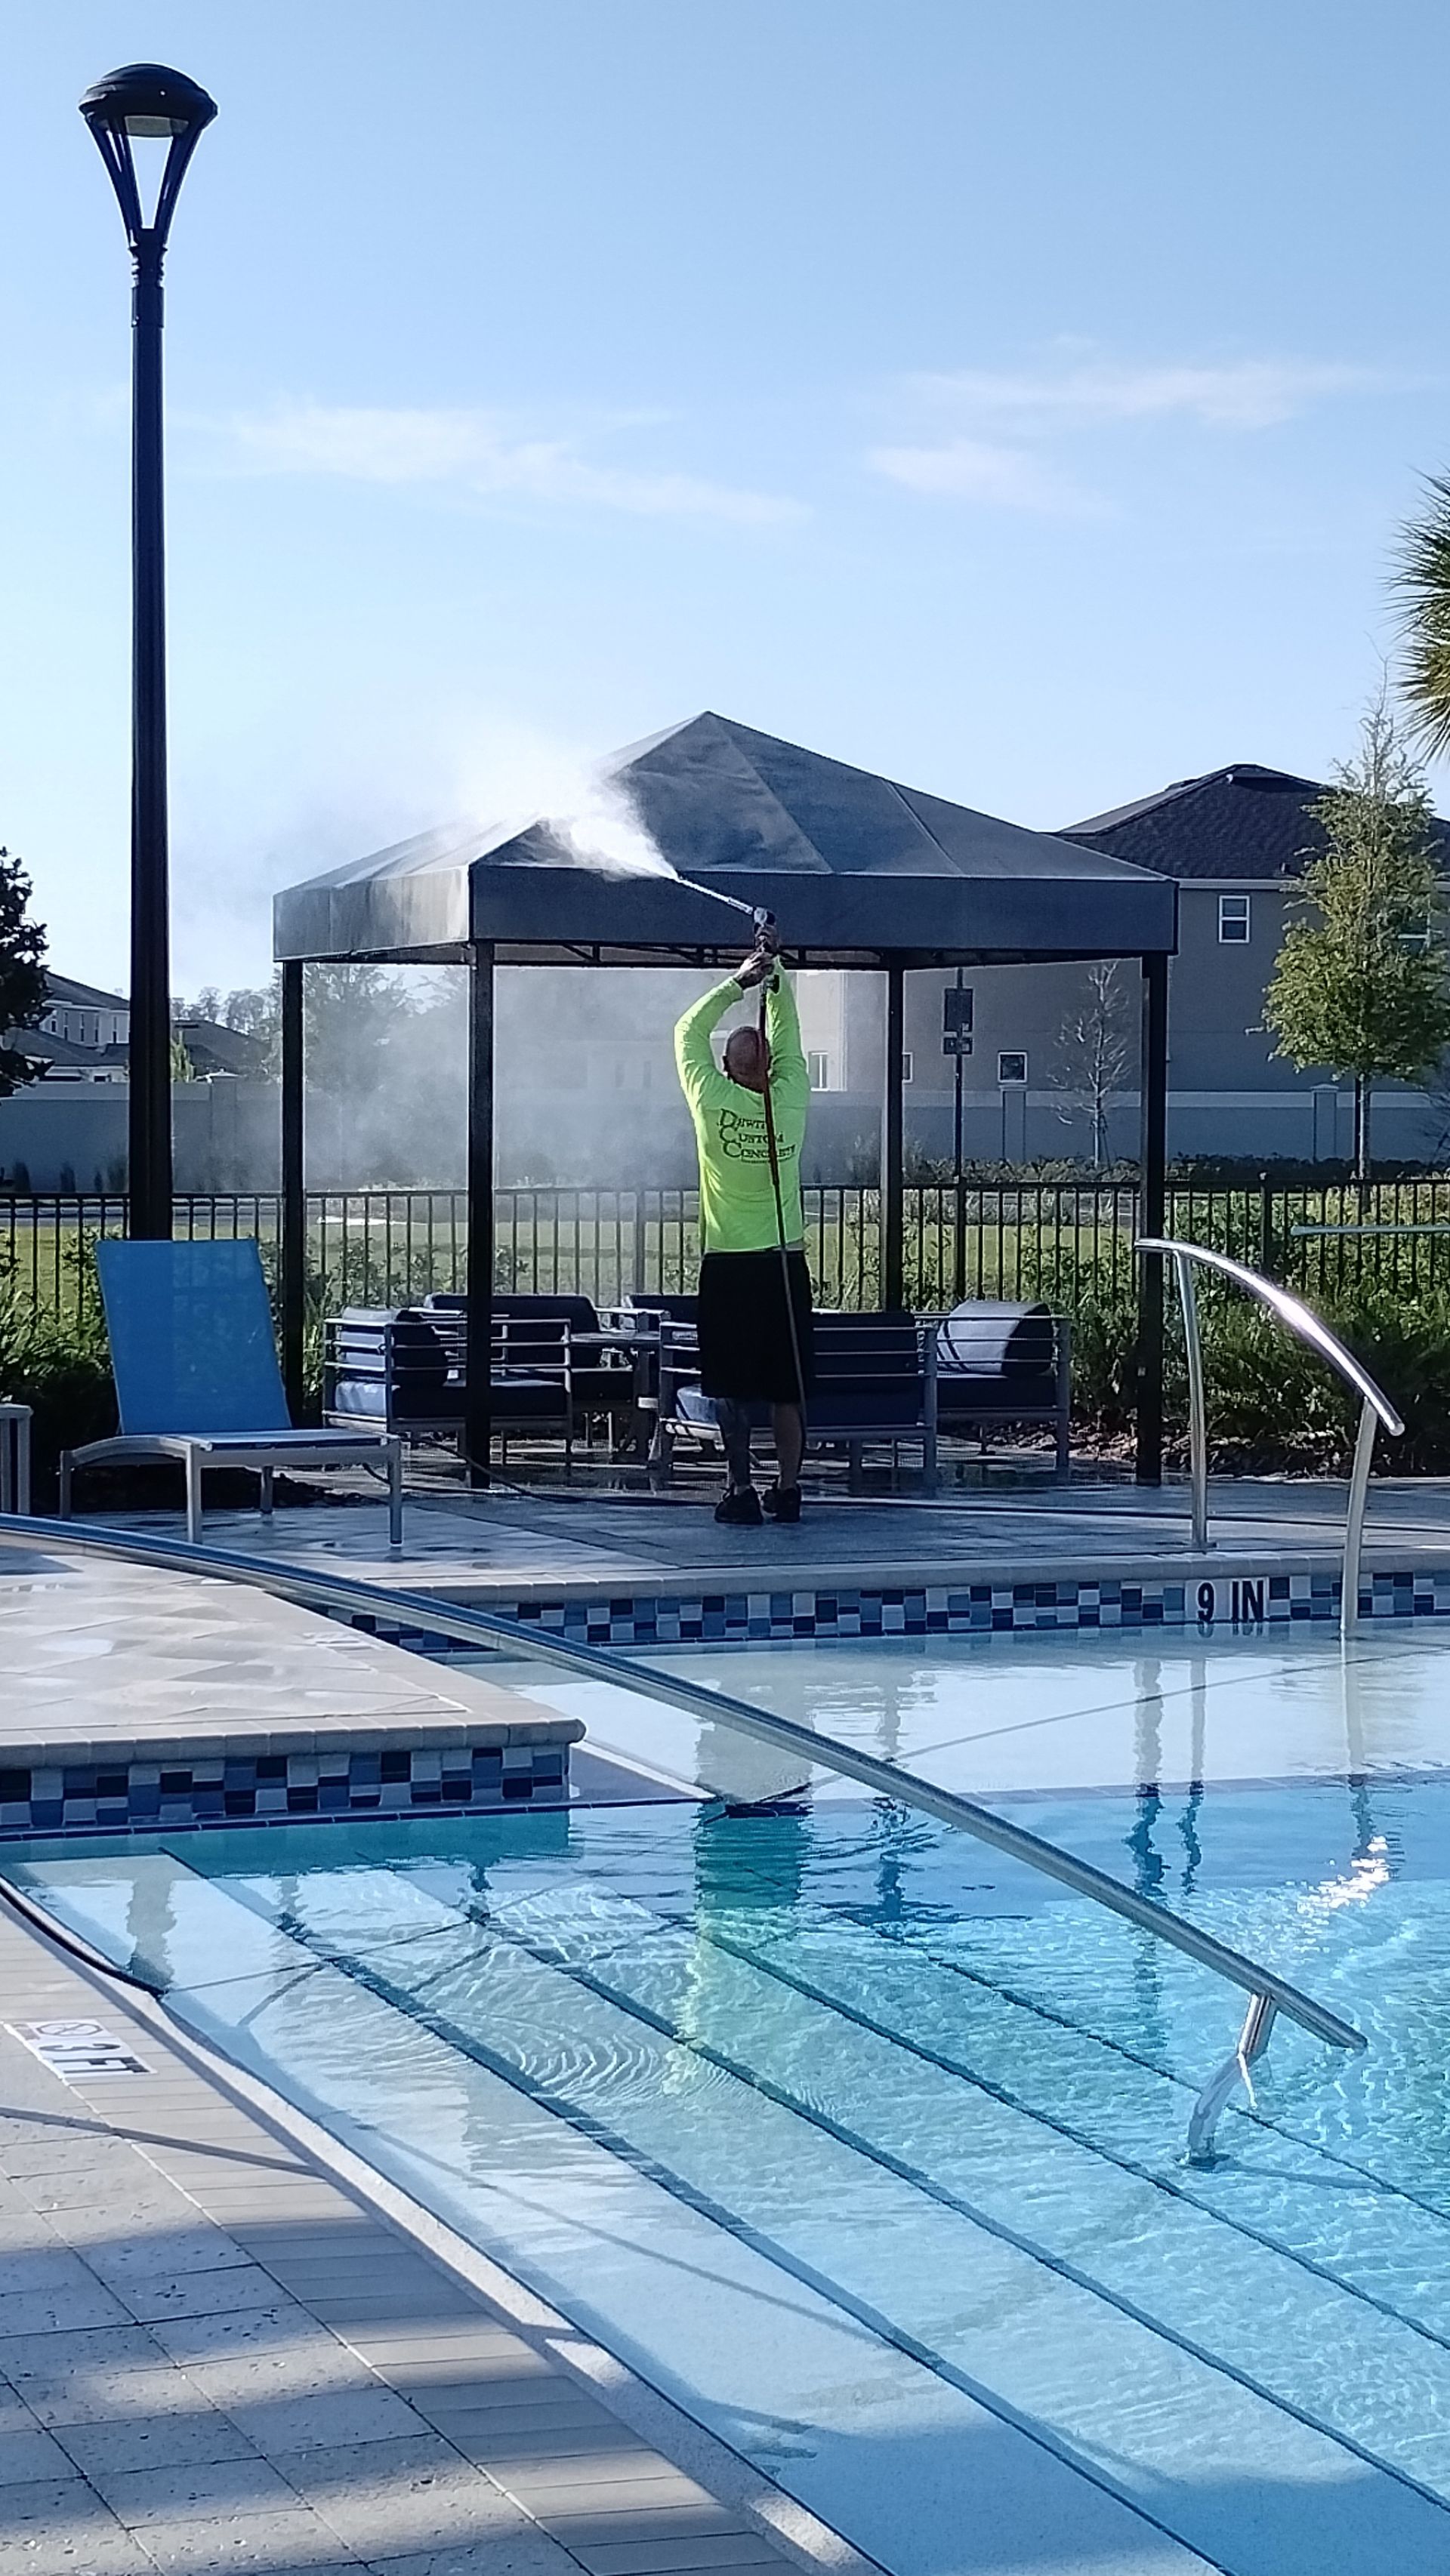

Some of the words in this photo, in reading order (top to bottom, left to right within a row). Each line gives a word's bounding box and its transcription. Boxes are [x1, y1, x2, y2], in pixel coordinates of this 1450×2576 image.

[1198, 1582, 1214, 1623] 9
[1232, 1579, 1264, 1622] IN
[39, 2043, 121, 2052] 3
[53, 2057, 150, 2073] FT
